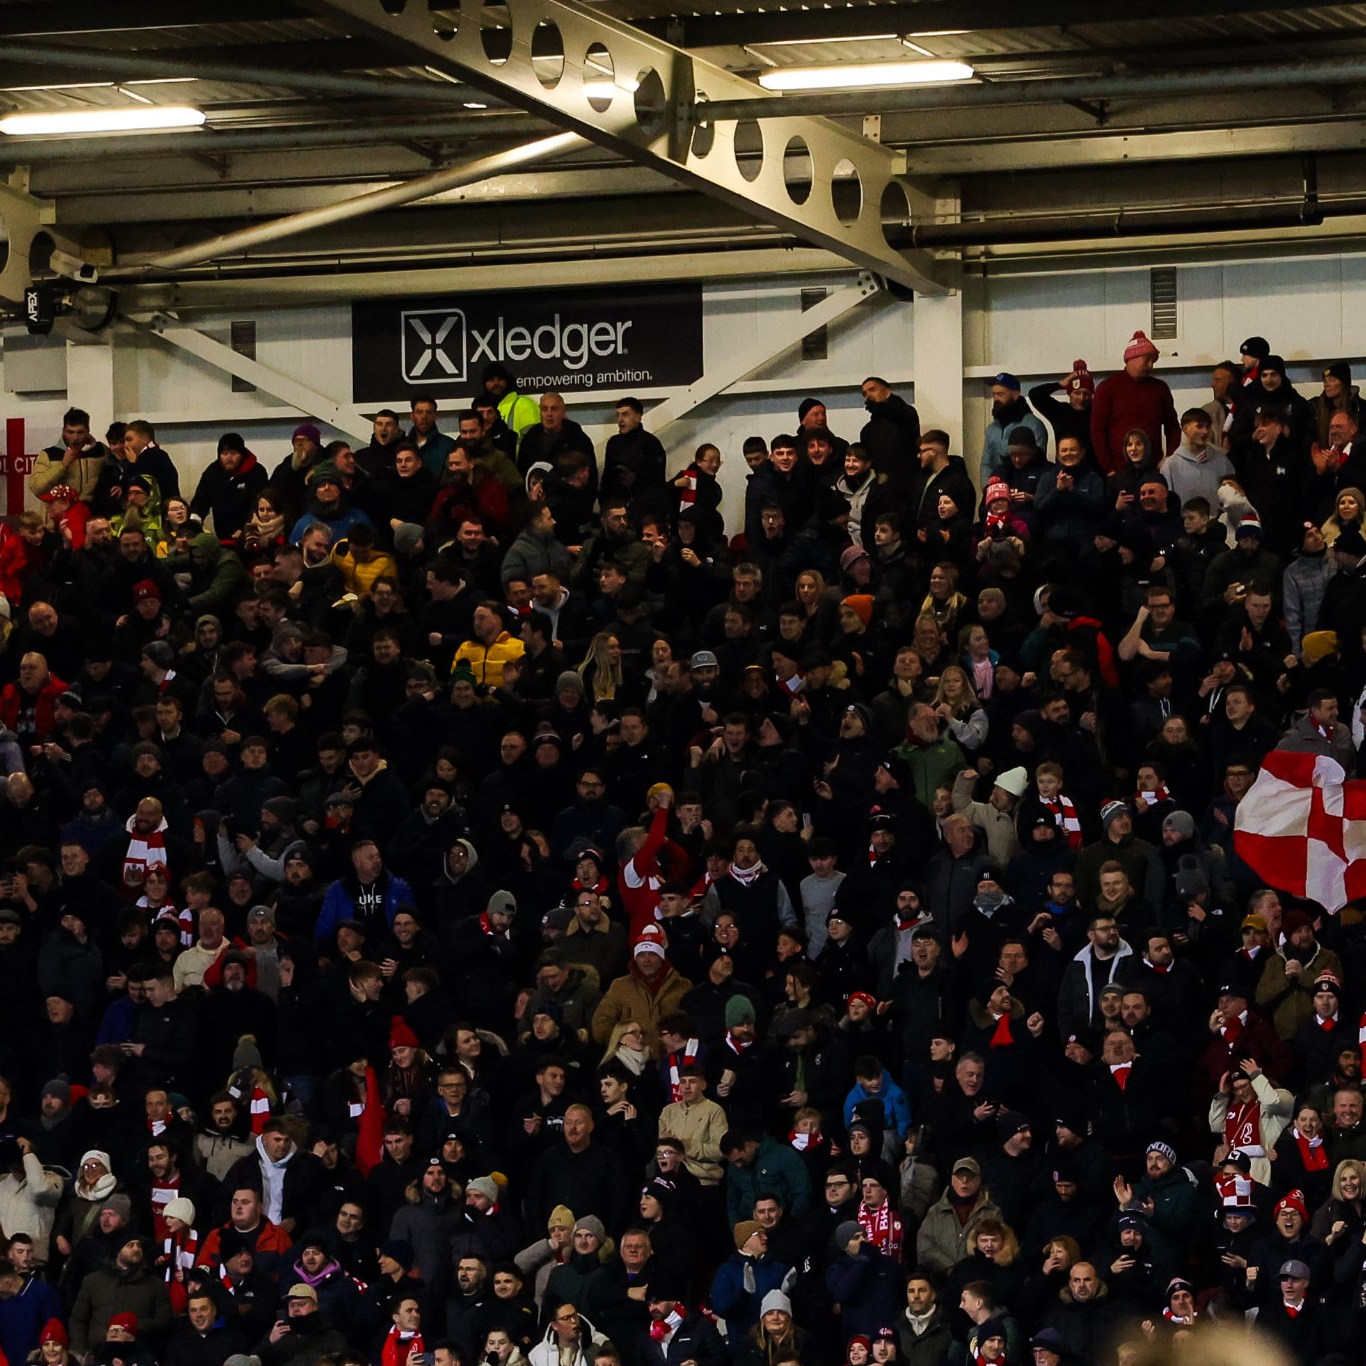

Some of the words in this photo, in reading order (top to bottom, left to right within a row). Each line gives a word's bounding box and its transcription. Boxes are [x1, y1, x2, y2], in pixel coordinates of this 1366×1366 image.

[28, 291, 38, 322] APEX
[470, 314, 633, 370] xledger
[515, 370, 594, 389] empowering
